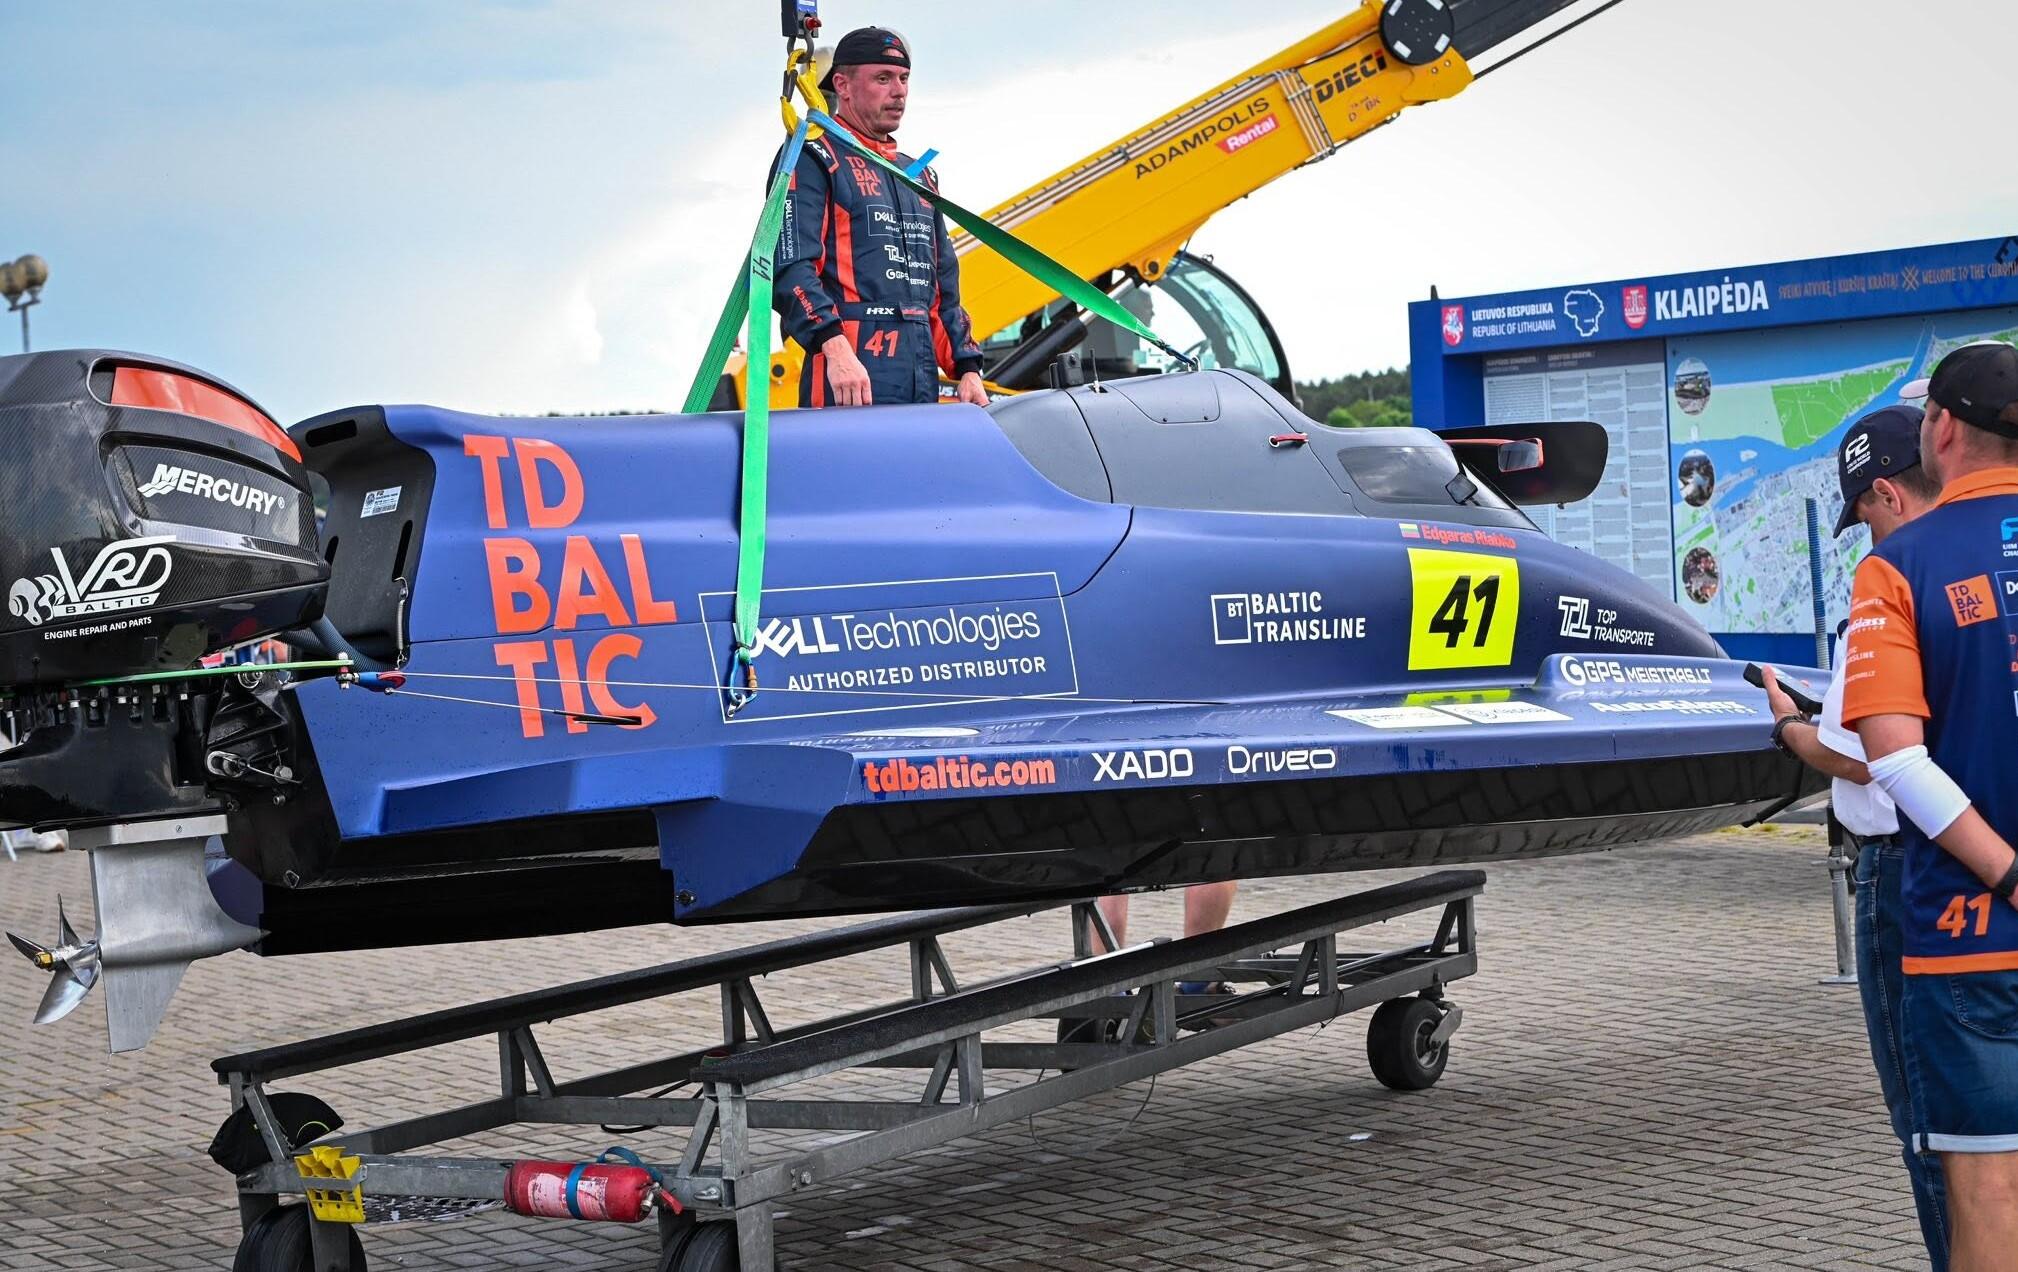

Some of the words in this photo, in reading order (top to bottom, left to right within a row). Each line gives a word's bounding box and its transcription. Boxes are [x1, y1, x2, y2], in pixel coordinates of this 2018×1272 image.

[1134, 97, 1271, 180] ADAMPOLIS
[1226, 117, 1276, 152] Rental
[845, 155, 866, 170] TD
[852, 168, 882, 184] BAL
[857, 182, 882, 197] TIC
[873, 211, 897, 224] DELL
[866, 307, 895, 315] HRX
[1654, 276, 1770, 321] KLAIPĖDA
[1471, 307, 1506, 322] LIETUVOS
[1506, 302, 1554, 317] RESPUBLIKA
[1472, 321, 1506, 338] REPUBLIC
[1506, 323, 1517, 334] OF
[1517, 319, 1557, 334] LITHUANIA
[864, 329, 899, 358] 41
[1845, 433, 1869, 463] F2
[138, 462, 276, 515] MERCURY
[462, 433, 585, 529] TD
[1420, 524, 1475, 544] Edgaras
[483, 533, 678, 634] BAL
[1950, 584, 1970, 599] TD
[65, 596, 151, 614] BALTIC
[1227, 602, 1243, 618] BT
[1251, 591, 1322, 615] BALTIC
[1428, 575, 1501, 649] 41
[1956, 594, 1983, 611] BAL
[1958, 606, 1982, 623] TIC
[44, 629, 78, 640] ENGINE
[79, 625, 108, 637] REPAIR
[109, 621, 128, 632] AND
[128, 616, 153, 629] PARTS
[831, 606, 1041, 651] Technologies
[1597, 608, 1617, 624] TOP
[1253, 617, 1366, 643] TRANSLINE
[1594, 626, 1655, 647] TRANSPORTE
[493, 632, 659, 738] TIC
[787, 665, 914, 691] AUTHORIZED
[921, 655, 1047, 681] DISTRIBUTOR
[1583, 660, 1626, 685] GPS
[1622, 666, 1713, 685] MEISTRAS.LT
[1091, 748, 1195, 782] XADO
[1227, 745, 1337, 774] Driveo
[863, 755, 1057, 793] tdbaltic.com
[1936, 893, 1993, 938] 41
